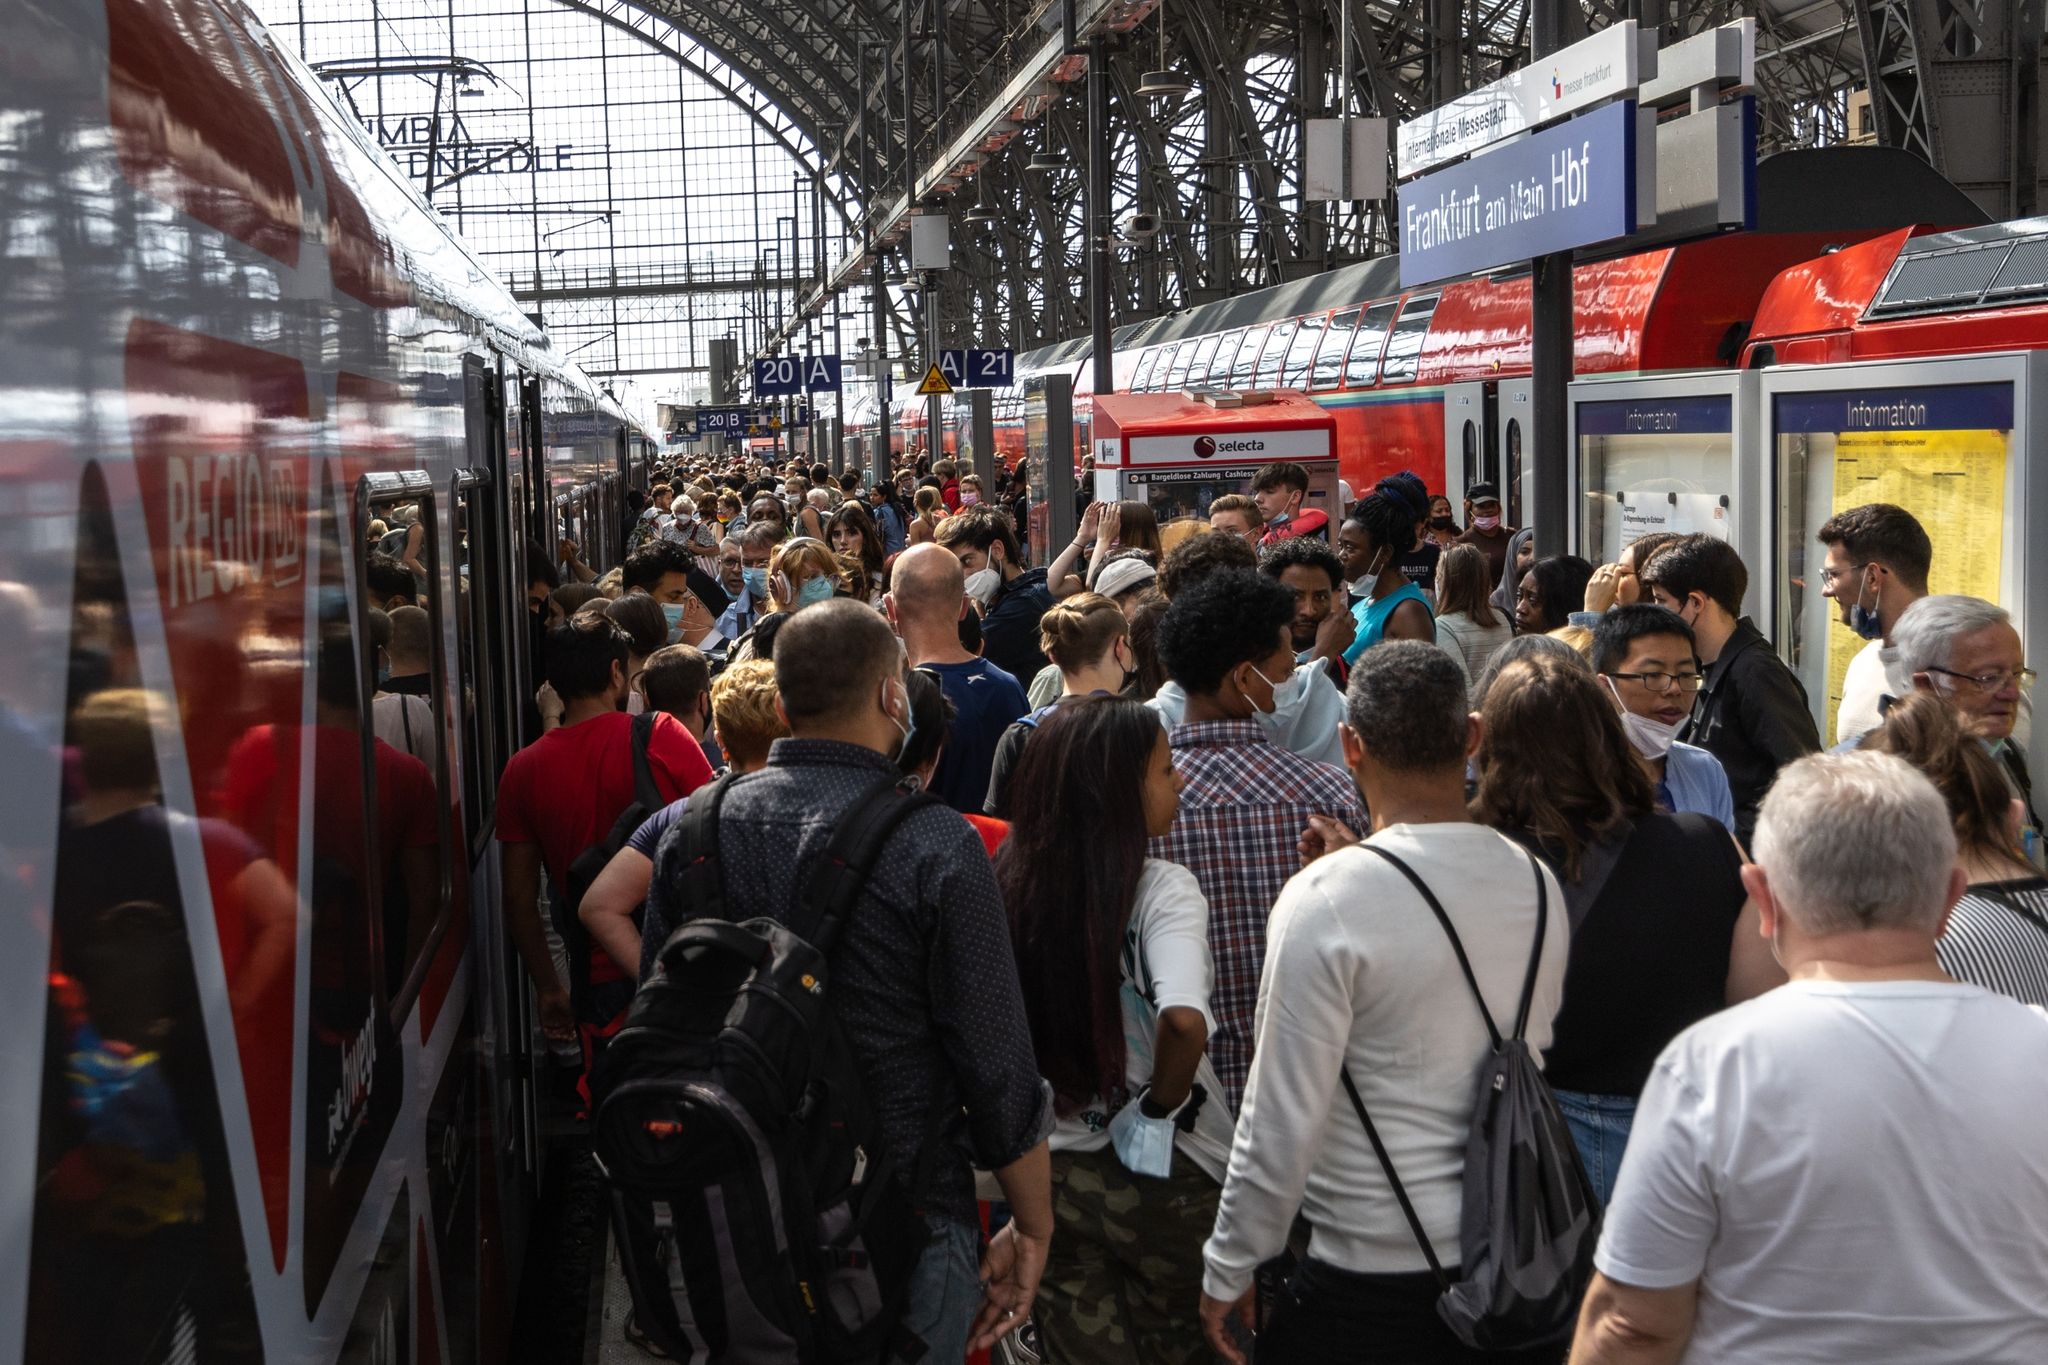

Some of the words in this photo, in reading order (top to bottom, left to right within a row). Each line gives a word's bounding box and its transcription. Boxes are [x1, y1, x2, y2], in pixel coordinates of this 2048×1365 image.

[1584, 63, 1611, 88] frankfurt
[1405, 122, 1456, 162] Internationale
[1458, 100, 1507, 140] Messestadt
[391, 144, 574, 178] DNEEDLE
[1406, 184, 1481, 254] Frankfurt
[1485, 199, 1506, 230] am
[1510, 177, 1544, 224] Main
[1552, 141, 1590, 211] Hbf
[762, 360, 793, 384] 20
[808, 358, 831, 384] A
[941, 352, 960, 378] A
[981, 352, 1007, 375] 21
[709, 415, 724, 426] 20
[730, 413, 740, 426] B
[1625, 408, 1678, 431] Information
[1847, 400, 1926, 427] Information
[1218, 440, 1265, 452] selecta
[1151, 473, 1192, 482] Bargeldlose
[1193, 472, 1221, 480] Zahlung
[1225, 470, 1255, 479] Cashless
[167, 453, 265, 608] REGIO
